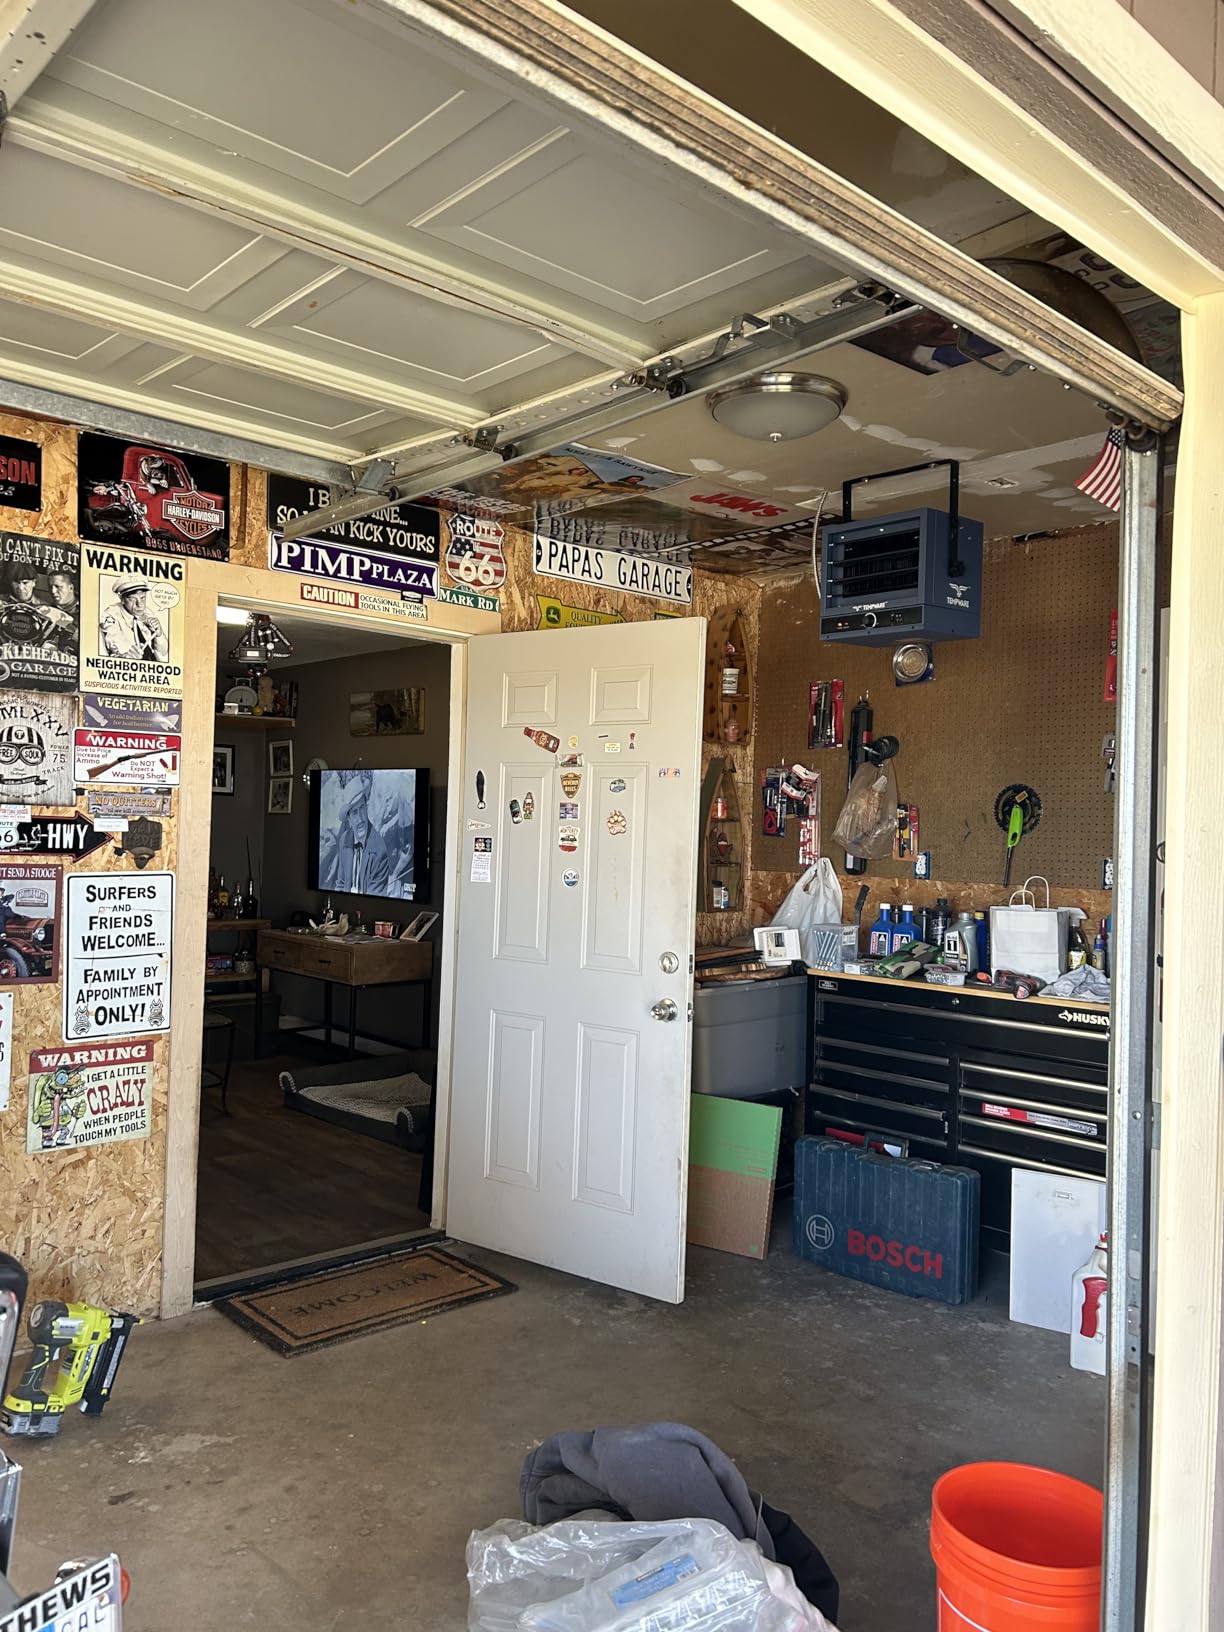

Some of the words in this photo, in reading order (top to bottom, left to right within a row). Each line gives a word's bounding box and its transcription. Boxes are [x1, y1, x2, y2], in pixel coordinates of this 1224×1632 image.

[181, 496, 209, 509] MOTOR
[308, 488, 315, 506] I
[690, 493, 789, 517] JAWS
[167, 505, 220, 523] HARLEY-DAVIDSON
[180, 521, 208, 534] CYCLES
[456, 519, 497, 536] ROUTE
[350, 520, 383, 543] KICK
[386, 527, 435, 554] YOURS
[6, 538, 42, 558] CAN'T
[45, 545, 64, 563] FIX
[67, 551, 80, 566] IT
[145, 536, 168, 551] DOGS
[169, 541, 222, 559] UNDERSTAND
[12, 554, 41, 566] DON'T
[43, 559, 60, 571] PAY
[85, 548, 183, 581] WARNING
[277, 542, 371, 581] PIMP
[371, 563, 433, 589] PLAZA
[458, 551, 496, 586] 66
[549, 541, 604, 580] PAPAS
[617, 555, 683, 597] GARAGE
[303, 583, 356, 607] CAUTION
[360, 594, 401, 608] OCCASIONAL
[402, 603, 424, 612] FLYING
[439, 588, 475, 608] MARK
[360, 602, 381, 612] TOOLS
[392, 607, 406, 616] THIS
[407, 610, 426, 620] AREA
[571, 611, 601, 625] QUALITY
[11, 661, 77, 677] GARAGE
[86, 657, 181, 676] NEIGHBORHOOD
[98, 669, 137, 683] WATCH
[140, 674, 170, 686] AREA
[84, 680, 119, 690] SUSPICIOUS
[120, 683, 152, 693] ACTIVITIES
[153, 686, 182, 695] REPORTED
[96, 696, 169, 712] VEGETARIAN
[90, 735, 167, 749] WARNING
[53, 753, 66, 763] 75
[42, 766, 65, 775] TRACK
[111, 771, 145, 780] Warning
[146, 772, 167, 780] Shot!
[0, 829, 13, 843] 6
[47, 823, 88, 849] HWY
[7, 868, 25, 878] SEND
[25, 868, 31, 878] A
[31, 868, 57, 878] STOOGE
[86, 884, 157, 903] SURFERS
[112, 904, 131, 912] AND
[89, 913, 153, 931] FRIENDS
[81, 932, 166, 952] WELCOME...
[84, 967, 137, 984] FAMILY
[143, 966, 159, 978] BY
[75, 982, 163, 1004] APPOINTMENT
[94, 1003, 146, 1026] ONLY!
[38, 1045, 147, 1068] WARNING
[91, 1071, 108, 1083] GET
[109, 1069, 116, 1079] A
[117, 1065, 147, 1079] LITTLE
[86, 1078, 147, 1116] CRAZY
[83, 1115, 110, 1130] WHEN
[112, 1108, 147, 1124] PEOPLE
[73, 1129, 103, 1145] TOUCH
[104, 1126, 118, 1137] MY
[119, 1120, 147, 1135] TOOLS
[847, 1228, 943, 1280] BOSCH
